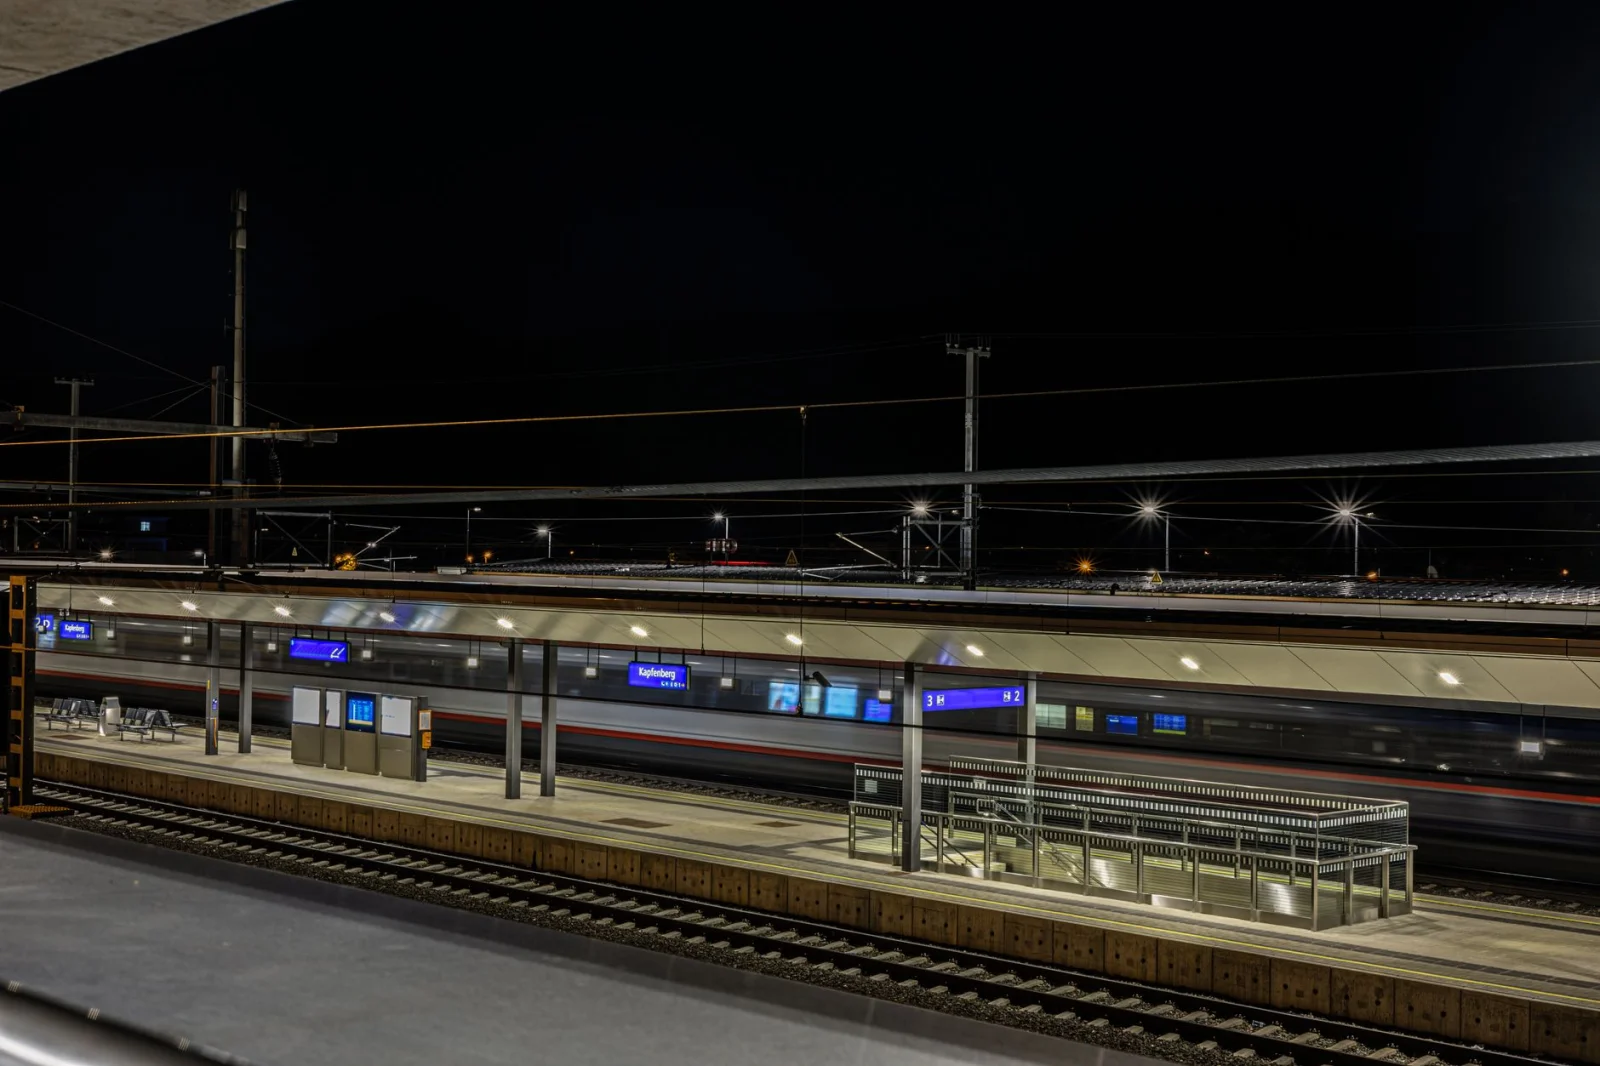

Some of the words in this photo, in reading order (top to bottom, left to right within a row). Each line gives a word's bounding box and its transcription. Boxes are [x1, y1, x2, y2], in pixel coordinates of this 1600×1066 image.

[638, 667, 676, 681] Kapfenberg
[926, 695, 933, 707] 3
[1014, 690, 1020, 702] 2
